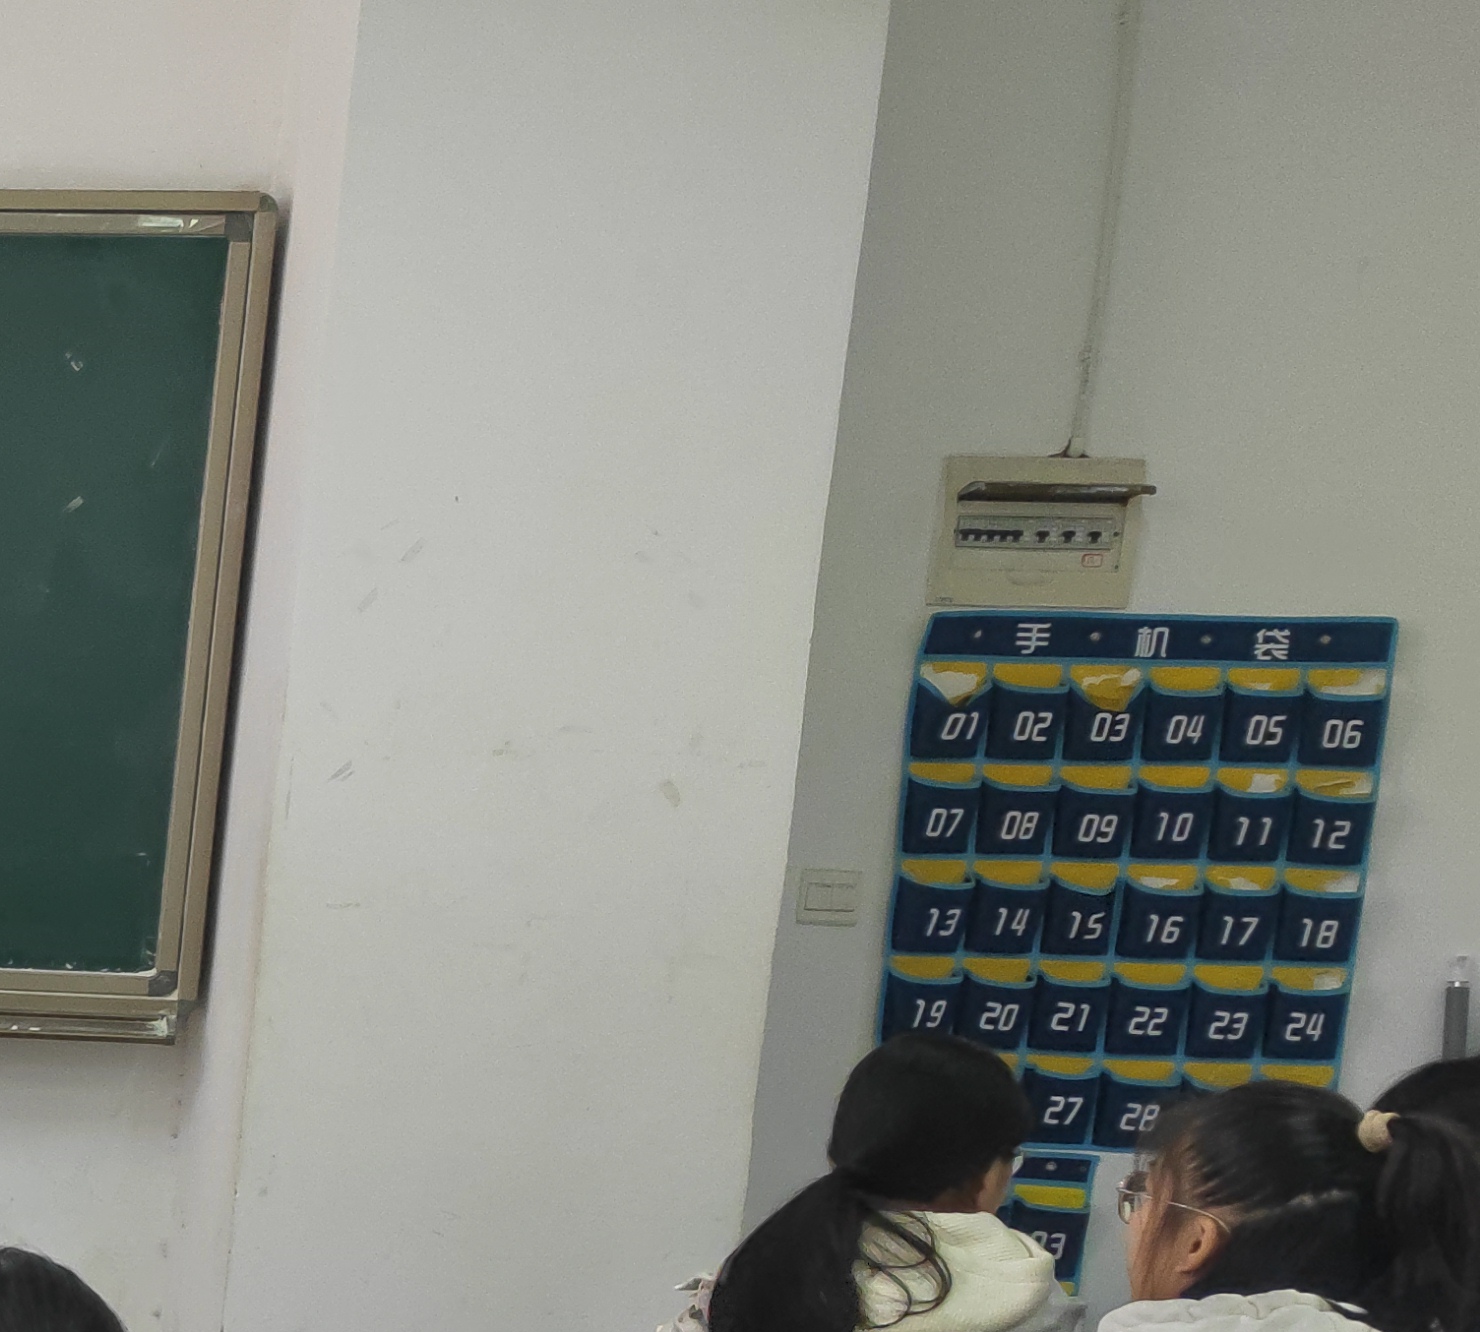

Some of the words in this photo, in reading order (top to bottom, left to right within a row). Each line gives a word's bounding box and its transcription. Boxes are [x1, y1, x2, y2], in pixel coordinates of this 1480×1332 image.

[1015, 622, 1290, 661] 手机袋
[940, 712, 979, 742] 01
[1013, 712, 1053, 743] 02
[1090, 712, 1130, 743] 03
[1166, 715, 1203, 745] 04
[1246, 715, 1287, 746] 05
[1322, 719, 1364, 749] 06
[925, 808, 964, 838] 07
[1000, 811, 1039, 841] 08
[1078, 813, 1118, 844] 09
[1157, 812, 1194, 843] 10
[1235, 816, 1272, 847] 11
[1311, 819, 1352, 850] 12
[925, 908, 961, 937] 13
[994, 907, 1030, 937] 14
[1068, 911, 1106, 940] 15
[1146, 914, 1184, 944] 16
[1221, 916, 1259, 946] 17
[1301, 918, 1340, 949] 18
[912, 999, 947, 1029] 19
[979, 1002, 1020, 1032] 20
[1050, 1002, 1088, 1033] 21
[1128, 1007, 1168, 1037] 22
[1207, 1011, 1249, 1041] 23
[1284, 1012, 1326, 1043] 24
[1043, 1096, 1084, 1126] 27
[1120, 1103, 1160, 1131] 28
